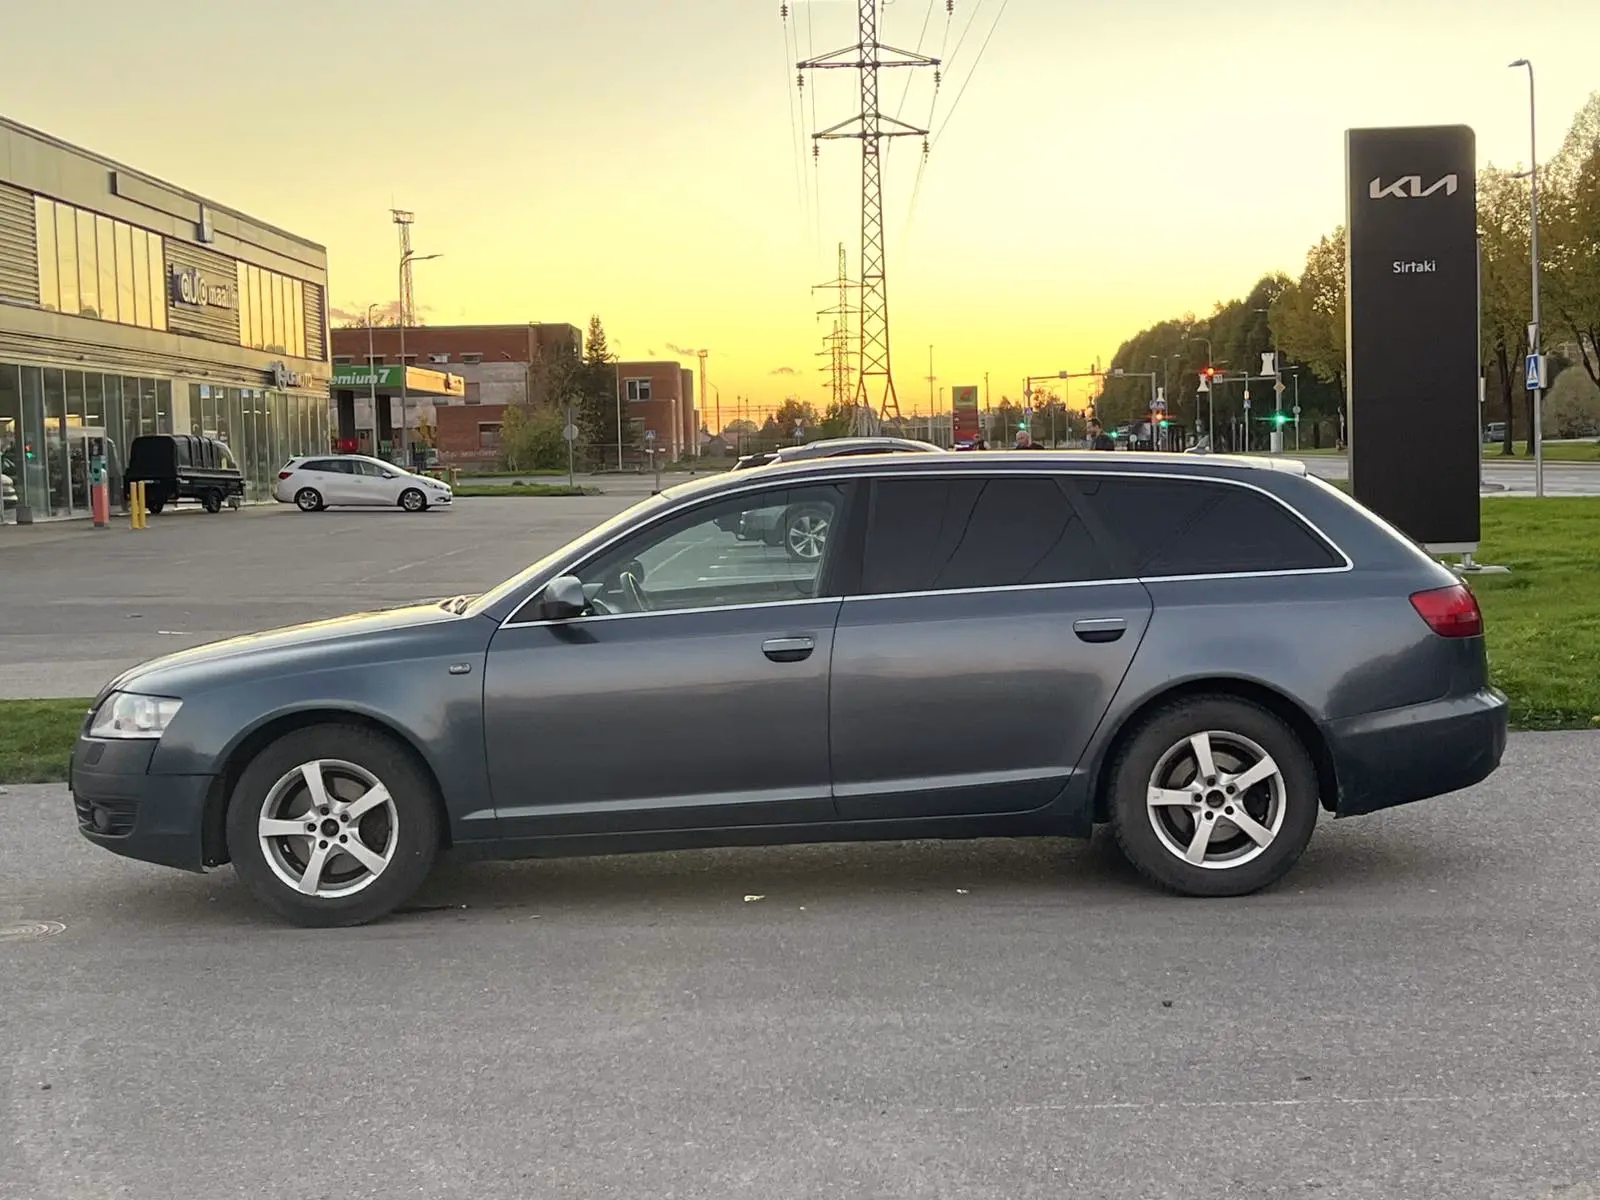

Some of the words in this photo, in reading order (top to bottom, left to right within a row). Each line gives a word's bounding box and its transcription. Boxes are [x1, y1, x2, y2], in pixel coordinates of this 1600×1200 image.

[1369, 174, 1458, 199] KIA
[1392, 260, 1437, 274] Sirtaki
[180, 268, 208, 306] auto
